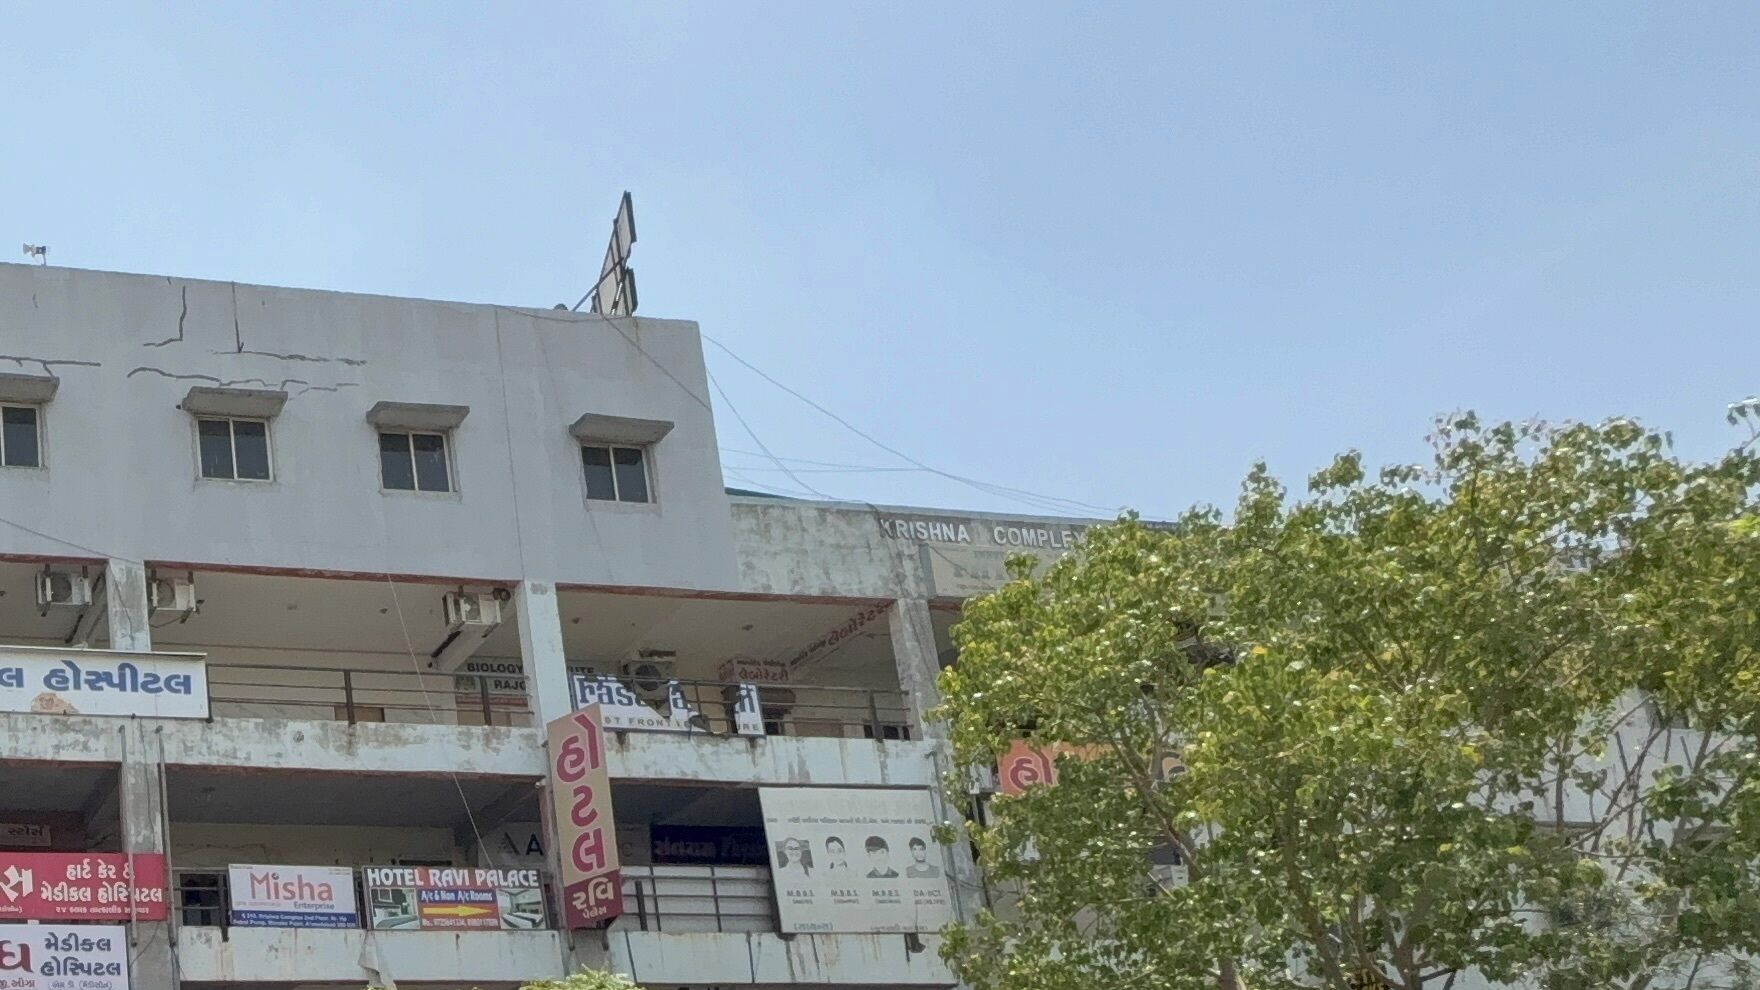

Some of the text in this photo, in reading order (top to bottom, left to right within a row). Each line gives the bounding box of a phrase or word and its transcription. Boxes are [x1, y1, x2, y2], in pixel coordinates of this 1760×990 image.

[880, 519, 971, 543] KRISHNA
[249, 871, 334, 901] Misha
[367, 868, 539, 888] HOTEL RAVI PALACE
[293, 902, 335, 911] Enterprise
[45, 932, 111, 952] મેડીકલ
